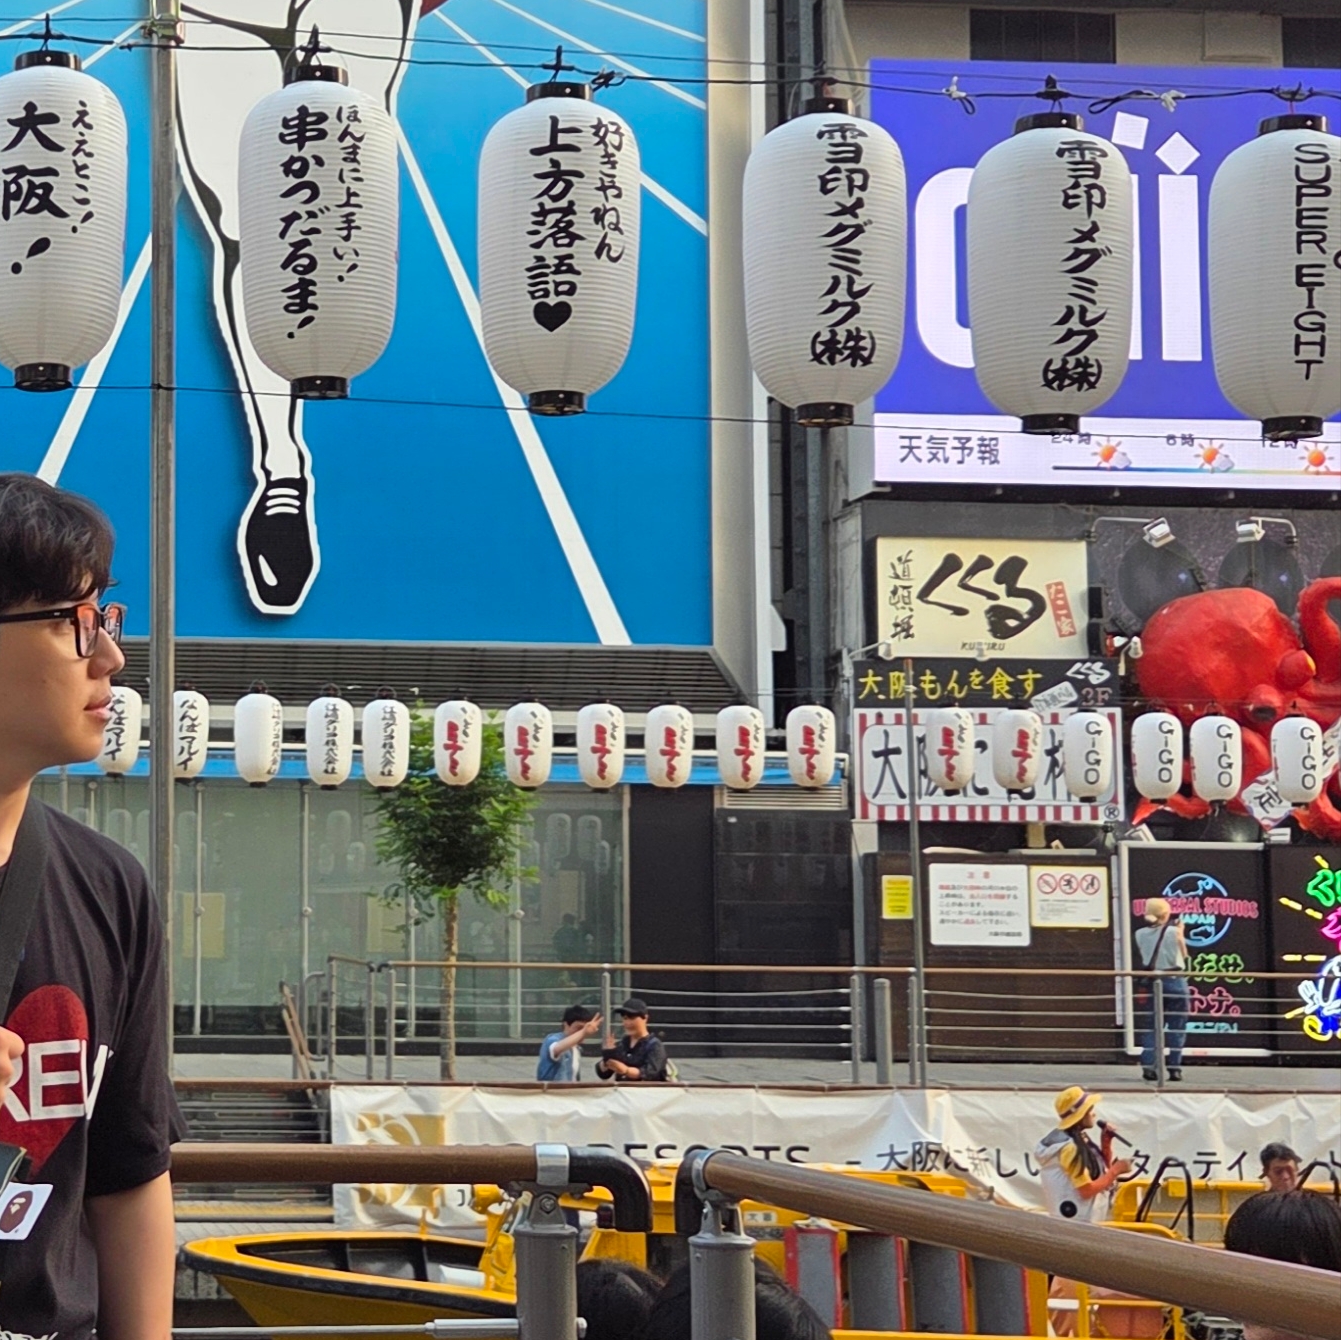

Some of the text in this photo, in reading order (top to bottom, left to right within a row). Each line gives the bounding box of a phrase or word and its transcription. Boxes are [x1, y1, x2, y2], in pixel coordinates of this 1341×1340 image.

[0, 100, 67, 275] 大阪！
[69, 100, 96, 235] ええとこ！
[278, 104, 330, 339] 串かつだるま！
[333, 105, 366, 282] ほんまに上手い！
[526, 114, 587, 300] 上方落語
[589, 116, 626, 264] 好きやねん
[1293, 143, 1332, 381] SUPER EIGHT
[899, 434, 1000, 465] 天気予報
[888, 550, 915, 642] 道頓堀
[916, 553, 1046, 640] くくる
[177, 699, 200, 771] なんばマルイ
[1066, 661, 1111, 685] くくる
